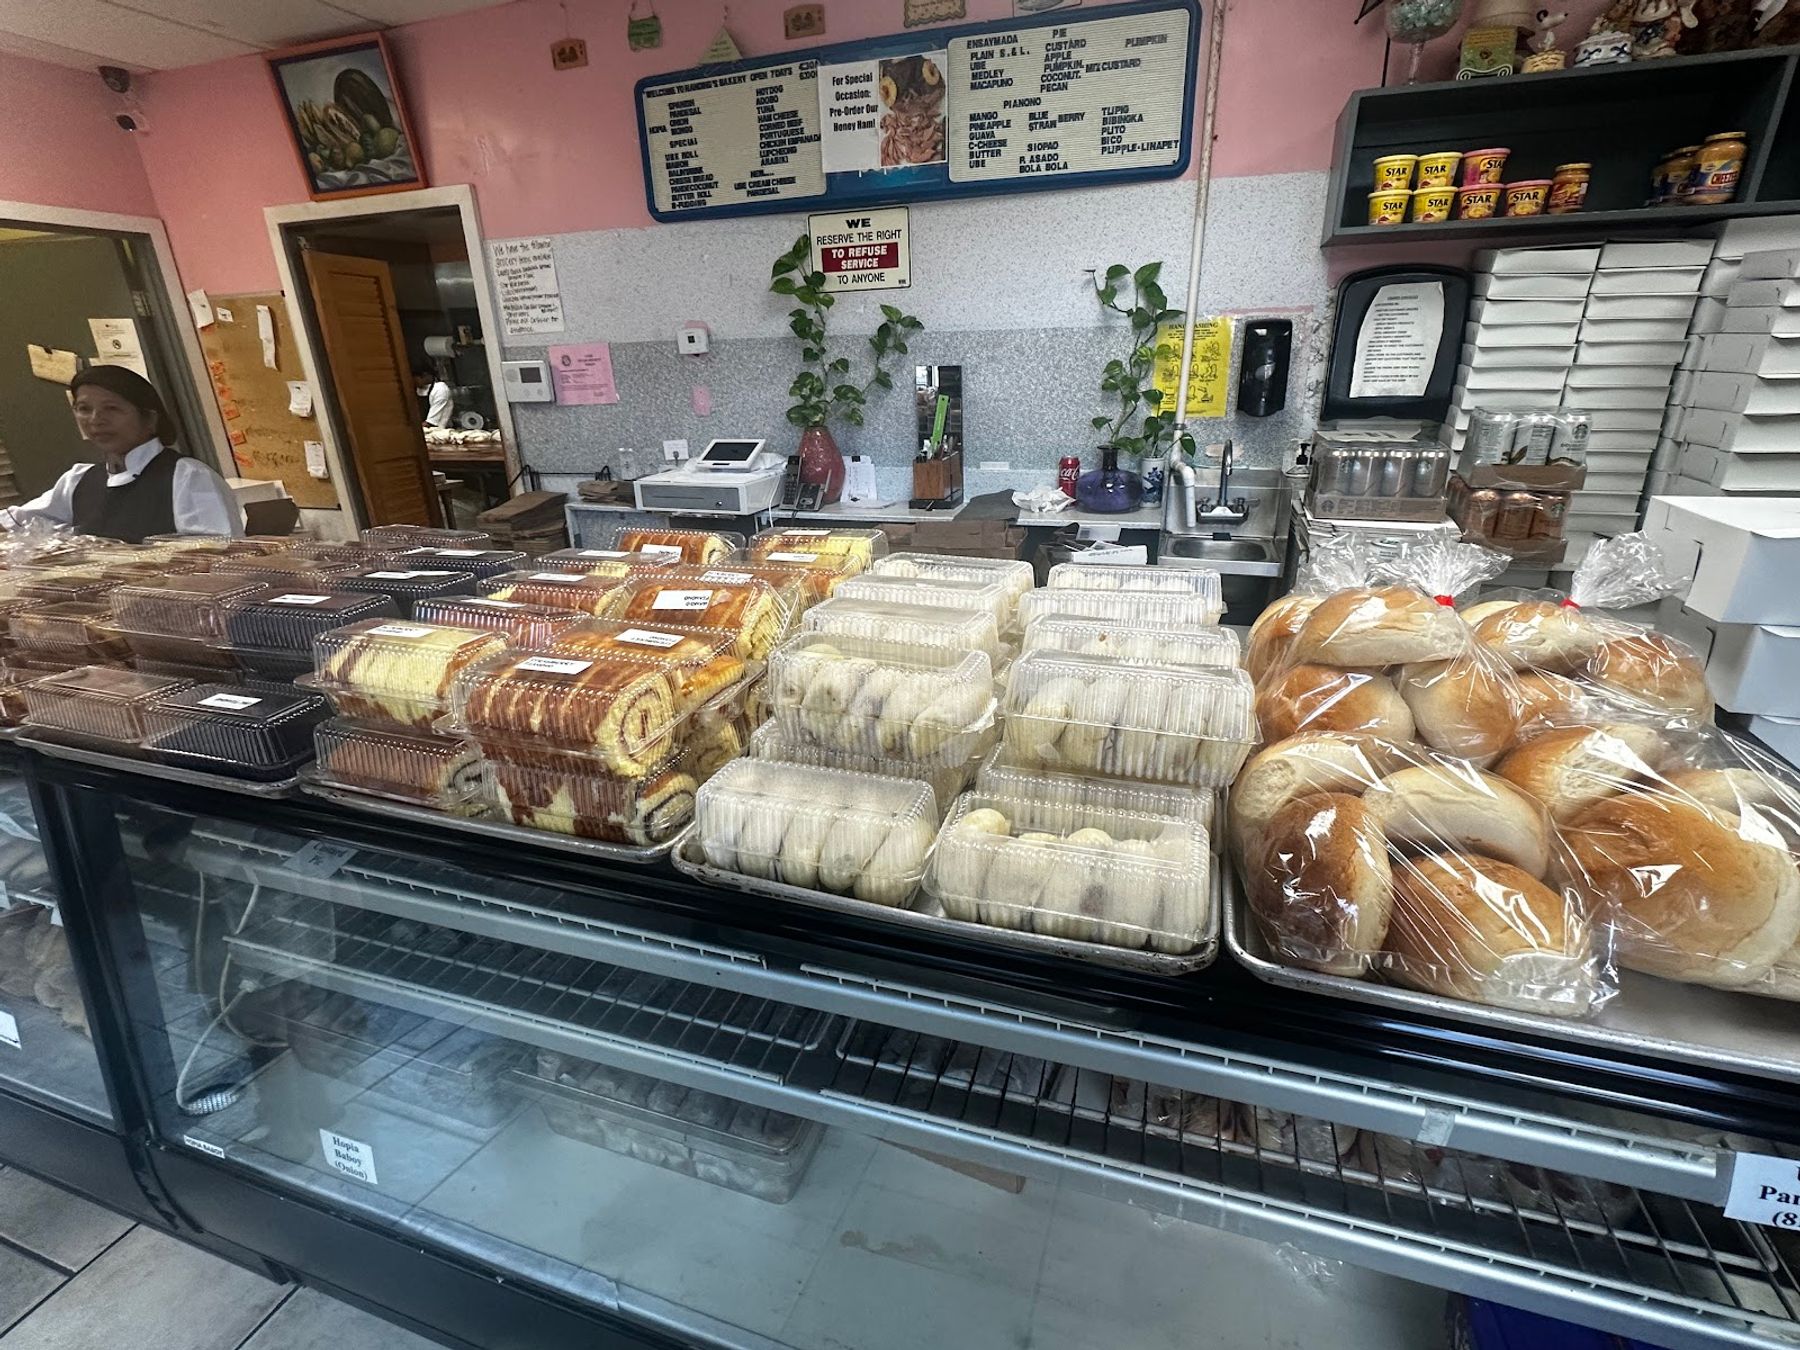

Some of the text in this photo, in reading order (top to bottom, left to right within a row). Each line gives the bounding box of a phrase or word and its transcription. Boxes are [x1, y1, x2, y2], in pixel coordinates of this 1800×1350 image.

[1052, 28, 1067, 38] PIE
[967, 34, 1018, 49] ENSAYMADA
[1045, 38, 1086, 52] CUSTARD
[1125, 34, 1168, 48] PUMPKIN
[970, 50, 994, 60] PLAIN
[1044, 50, 1072, 62] APPLE
[970, 61, 986, 70] UBE
[1102, 58, 1141, 70] CUSTARD
[719, 75, 746, 86] BAKERY
[750, 72, 767, 81] OPEN
[832, 72, 873, 86] For Special
[972, 68, 1004, 80] MEDLEY
[970, 78, 1014, 90] MACAPUNO
[1040, 82, 1068, 93] PECAN
[756, 95, 778, 106] ADOBO
[835, 90, 871, 101] Occasion:
[1004, 97, 1042, 109] PIANONO
[756, 104, 775, 114] TUNA
[829, 104, 878, 118] Pre-Order Our
[1102, 105, 1129, 116] TUPIG
[758, 110, 798, 123] HAM CHEESE
[970, 112, 998, 122] MANGO
[1028, 110, 1086, 123] BLUE BERRY
[1102, 114, 1144, 126] BIBINGKA
[760, 122, 786, 132] CORNED
[834, 121, 856, 132] Honey
[970, 120, 1012, 132] PINEAPPLE
[1028, 120, 1057, 132] STRAW
[1102, 126, 1126, 136] PUTO
[760, 127, 804, 140] PORTUGUESE
[969, 131, 996, 140] GUAVA
[670, 138, 698, 148] SPECIAL
[968, 139, 1008, 150] C-CHEESE
[1101, 136, 1122, 145] BICO
[1028, 141, 1059, 152] SIOPAO
[682, 150, 698, 160] ROLL
[970, 149, 1002, 160] BUTTER
[1030, 153, 1059, 164] ASADO
[970, 160, 986, 168] UBE
[1020, 162, 1068, 174] BOLA BOLA
[1487, 159, 1504, 169] STA
[1385, 168, 1408, 179] STAR
[1424, 165, 1446, 176] STAR
[693, 174, 714, 182] BREAD
[748, 179, 770, 188] CREAM
[672, 190, 712, 202] BUTTER ROLL
[1466, 194, 1492, 204] STAR
[1512, 192, 1539, 202] STAR
[1382, 202, 1403, 212] STAR
[1428, 198, 1448, 208] STAR
[846, 218, 871, 228] WE
[816, 229, 902, 245] RESERVE THE RIGHT
[832, 245, 888, 258] TO REFUSE
[841, 258, 878, 270] SERVICE
[837, 274, 848, 284] TO
[852, 272, 886, 284] ANYONE
[332, 1136, 359, 1153] Hopia
[335, 1160, 368, 1184] (Onion)
[1772, 1211, 1800, 1228] (8
